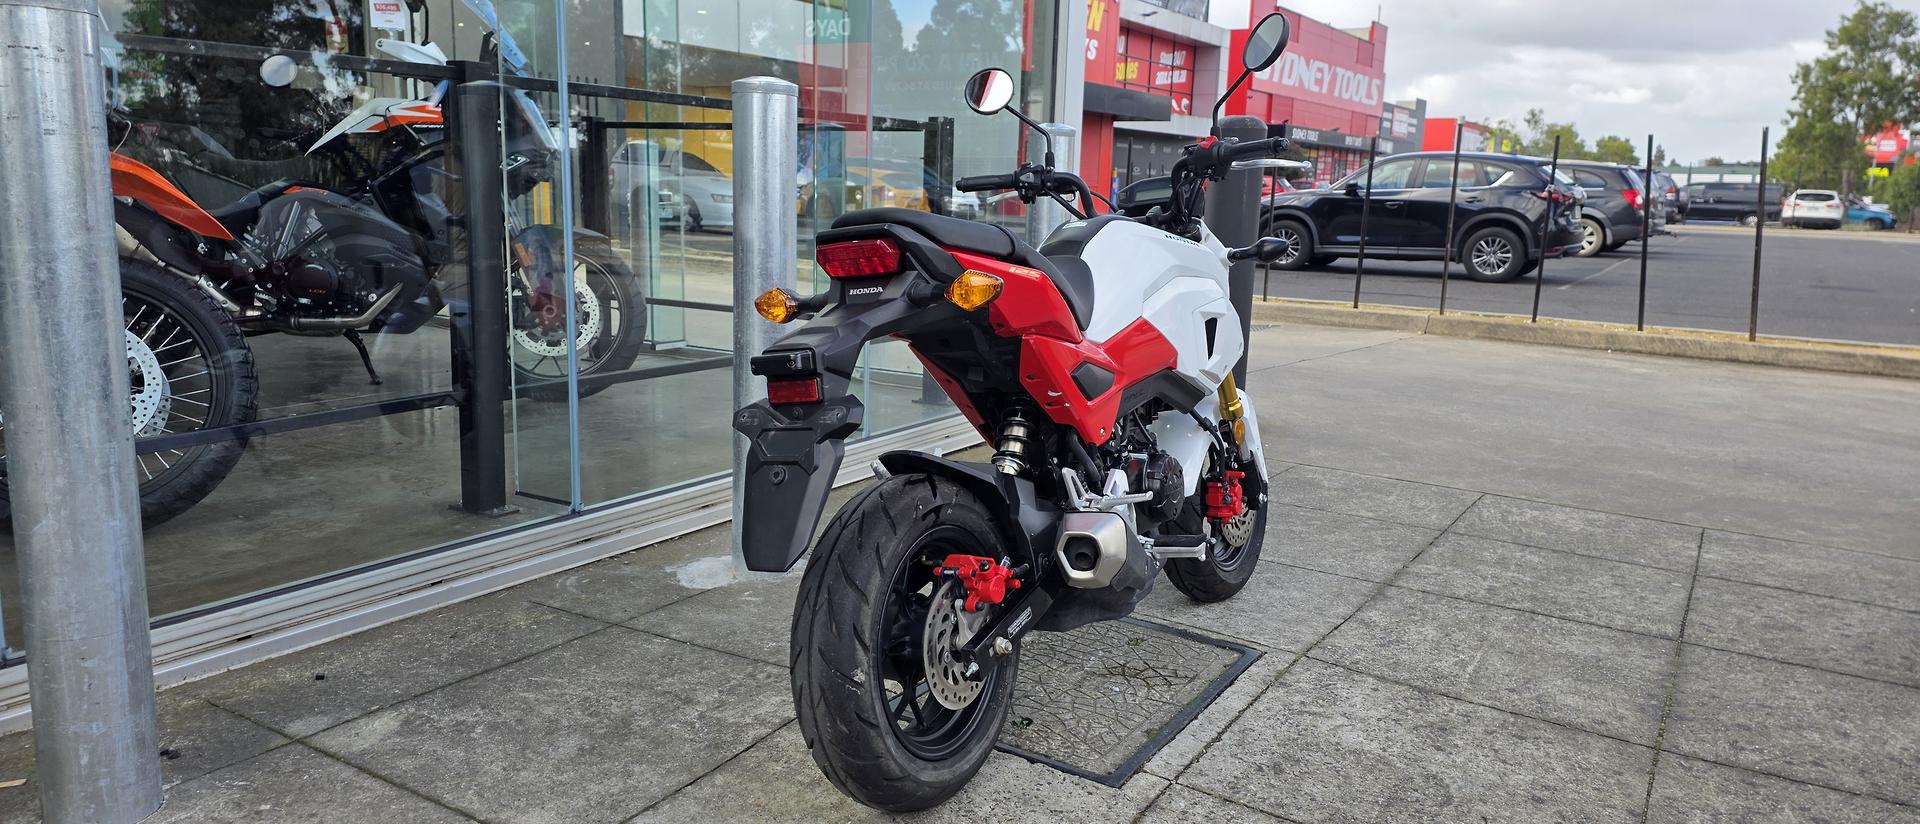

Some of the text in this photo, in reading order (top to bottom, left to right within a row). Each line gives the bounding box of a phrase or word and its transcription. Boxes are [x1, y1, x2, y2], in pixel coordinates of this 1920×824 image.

[1333, 66, 1380, 106] TOOLS
[1164, 234, 1200, 247] HONDA
[849, 286, 883, 295] HONDA
